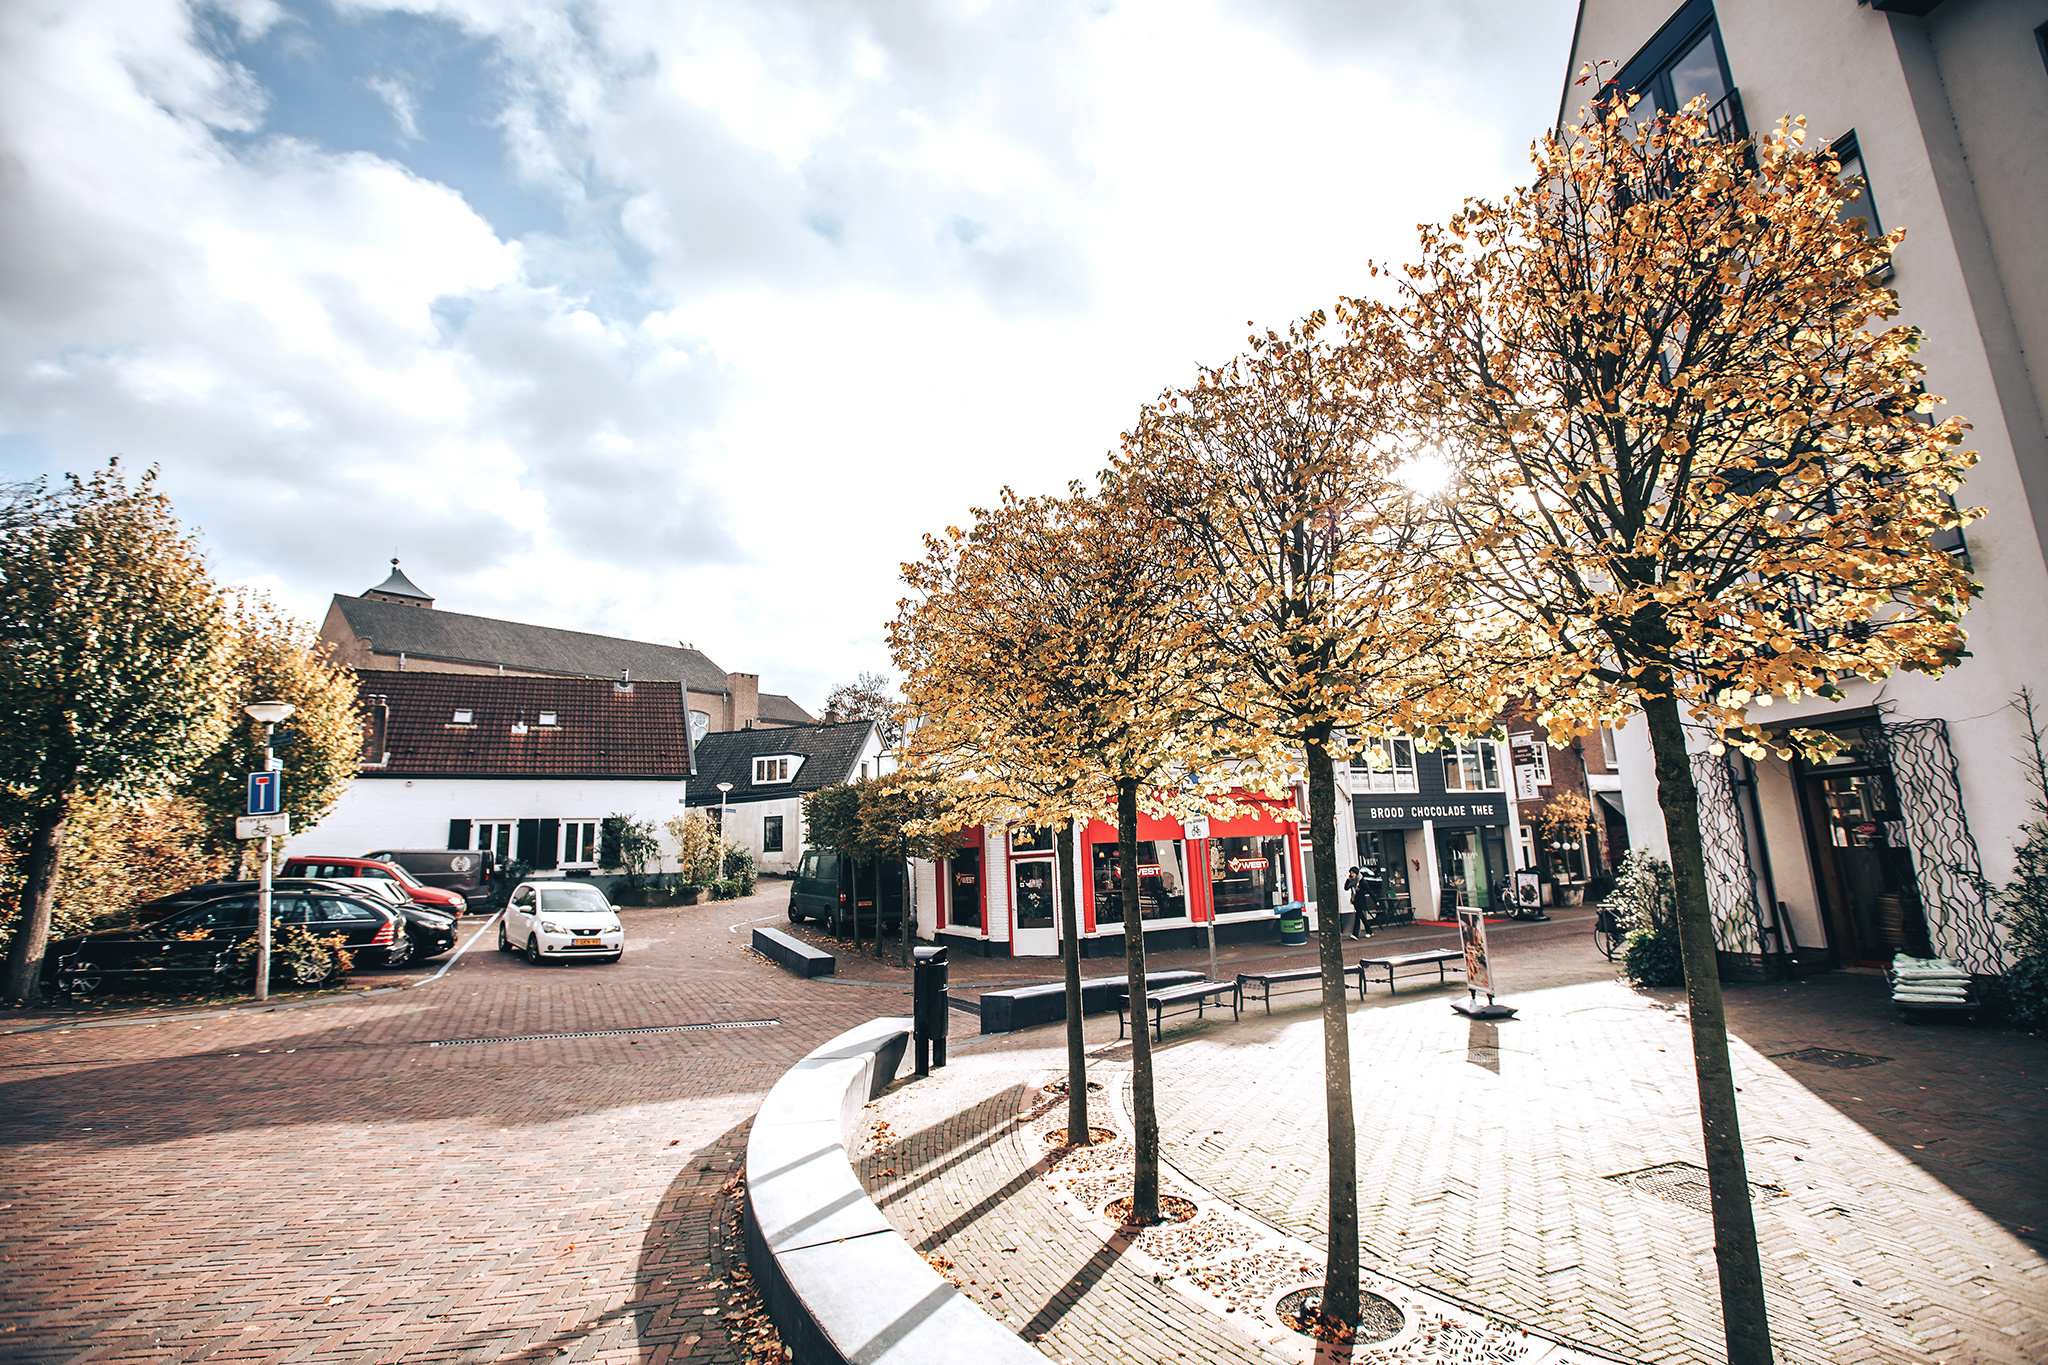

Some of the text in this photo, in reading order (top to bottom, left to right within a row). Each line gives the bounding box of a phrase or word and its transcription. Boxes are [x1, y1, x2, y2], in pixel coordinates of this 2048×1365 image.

[1370, 804, 1495, 819] BROOD CHOCOLADE THEE
[1241, 861, 1267, 869] WEST
[962, 876, 975, 884] WEST
